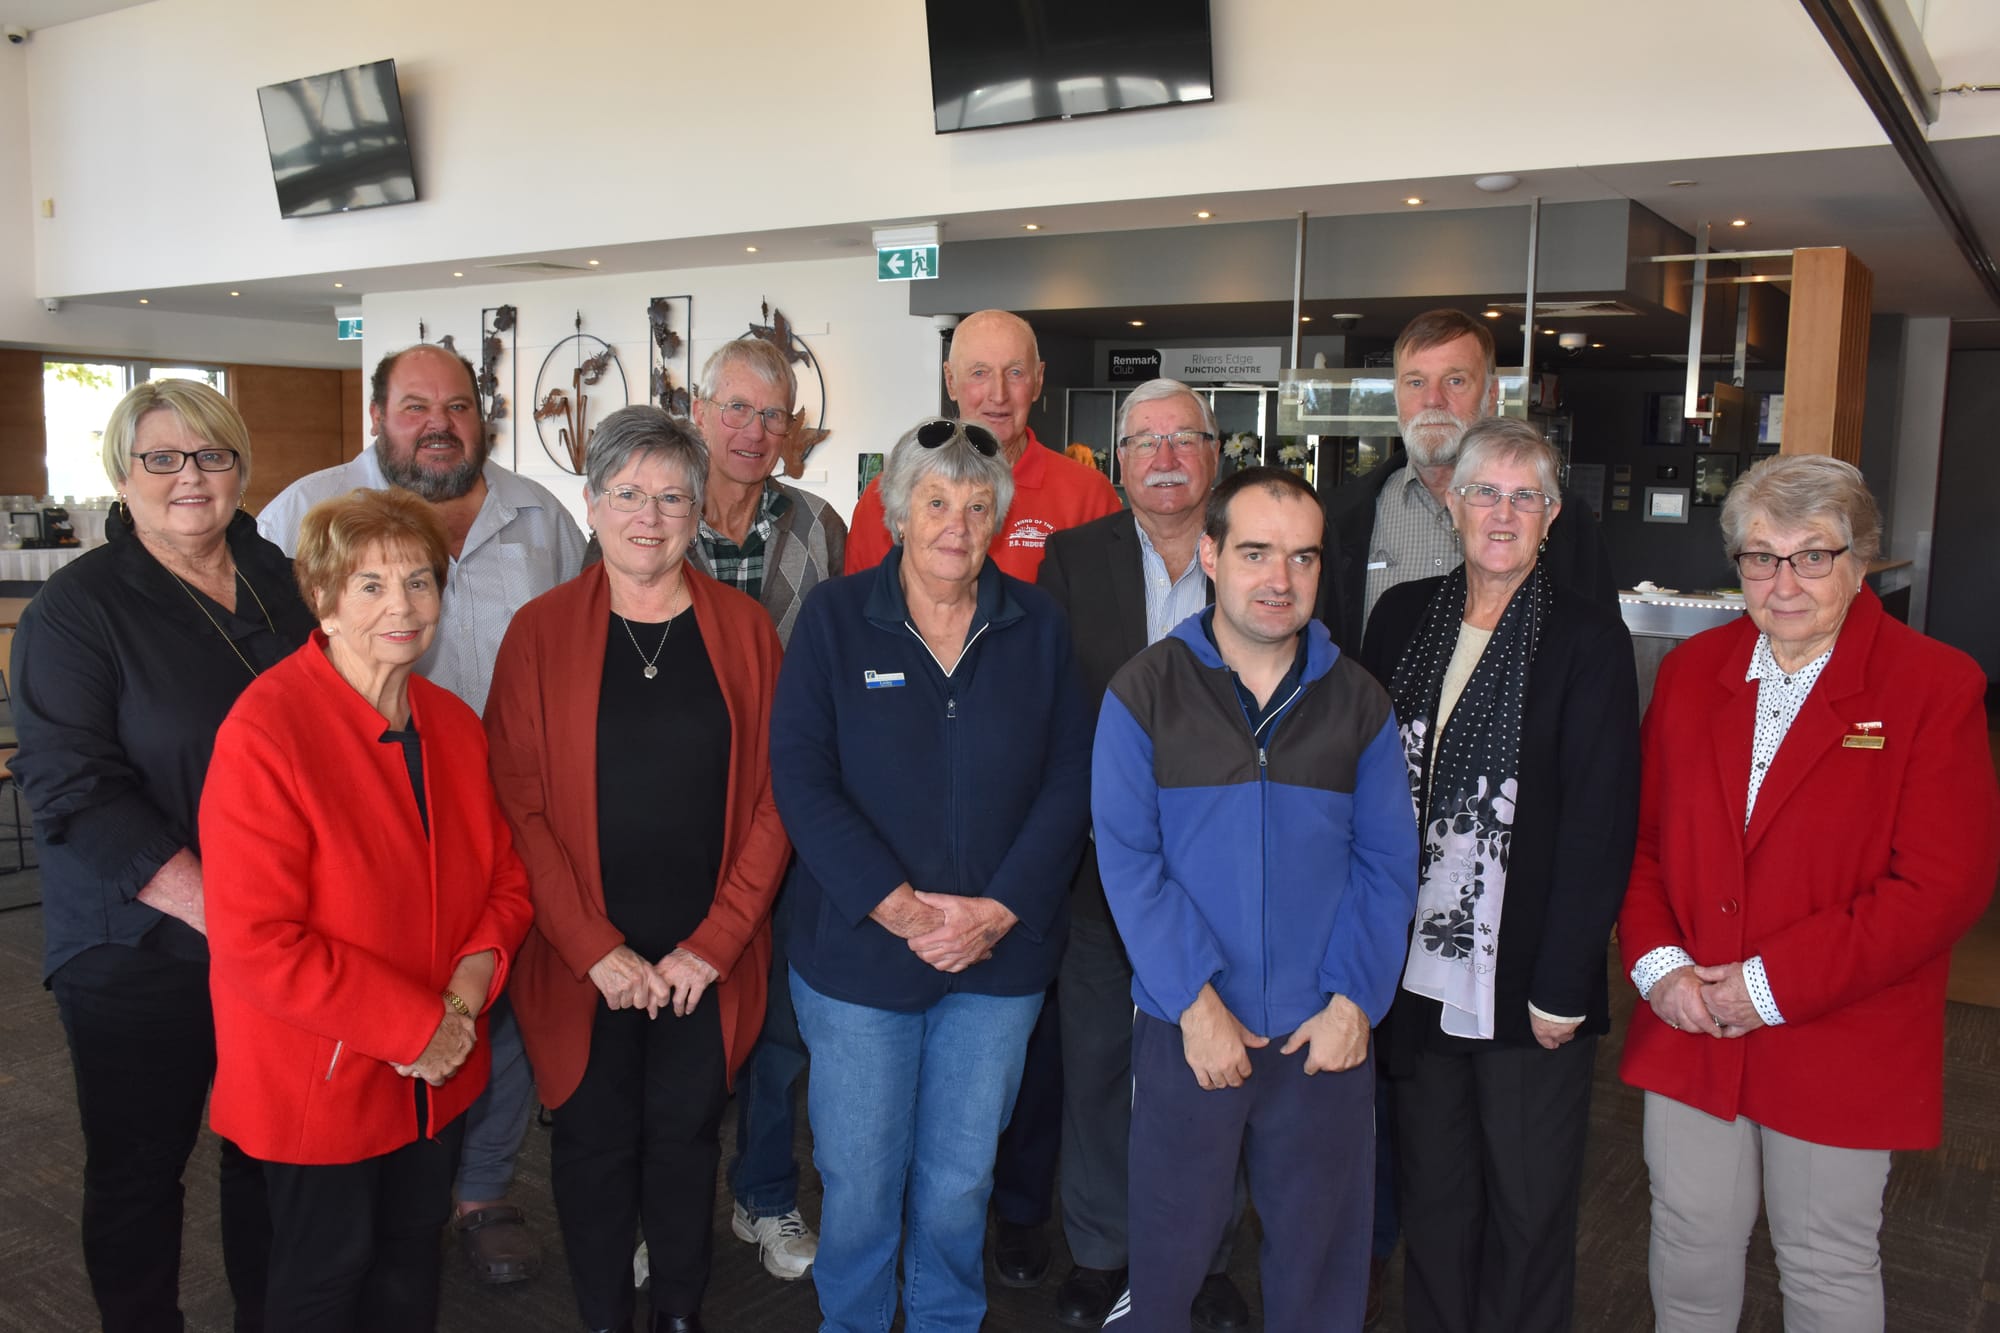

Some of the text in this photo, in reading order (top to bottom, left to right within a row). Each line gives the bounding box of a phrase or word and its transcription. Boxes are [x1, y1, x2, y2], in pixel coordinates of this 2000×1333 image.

[1113, 355, 1158, 365] Renmark
[1192, 354, 1253, 365] Rivers Edge
[1112, 365, 1135, 375] Club
[1184, 366, 1262, 374] FUNCTION CENTRE
[1014, 519, 1032, 527] FRIEND
[1044, 522, 1053, 530] THE
